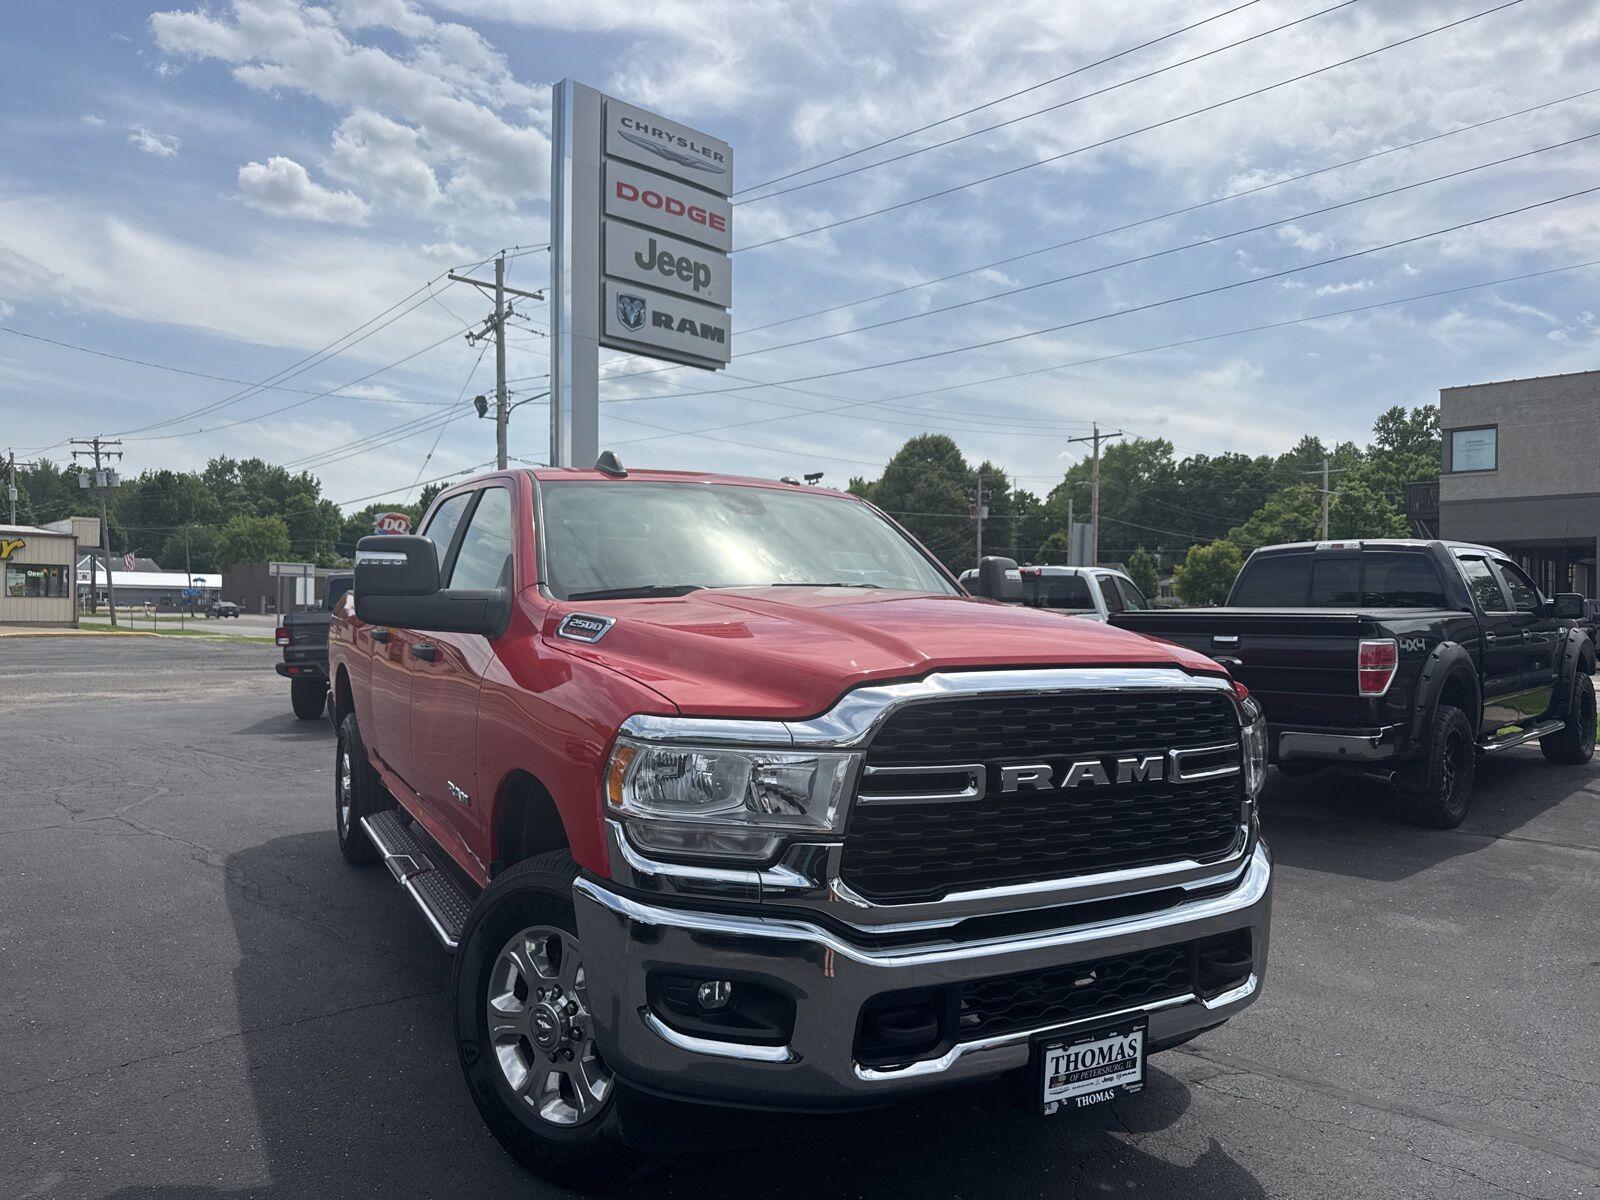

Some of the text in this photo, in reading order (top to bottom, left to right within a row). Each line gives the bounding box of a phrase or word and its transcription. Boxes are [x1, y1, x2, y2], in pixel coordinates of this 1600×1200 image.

[620, 117, 725, 164] CHRYSLER
[616, 181, 726, 233] DODGE
[634, 238, 712, 292] Jeep
[652, 310, 725, 344] RAM
[383, 518, 406, 534] DQ
[569, 618, 603, 631] 2500
[1001, 756, 1164, 793] RAM
[1051, 1038, 1137, 1076] THOMAS
[1069, 1073, 1080, 1082] OF
[1075, 1089, 1115, 1108] THOMAS
